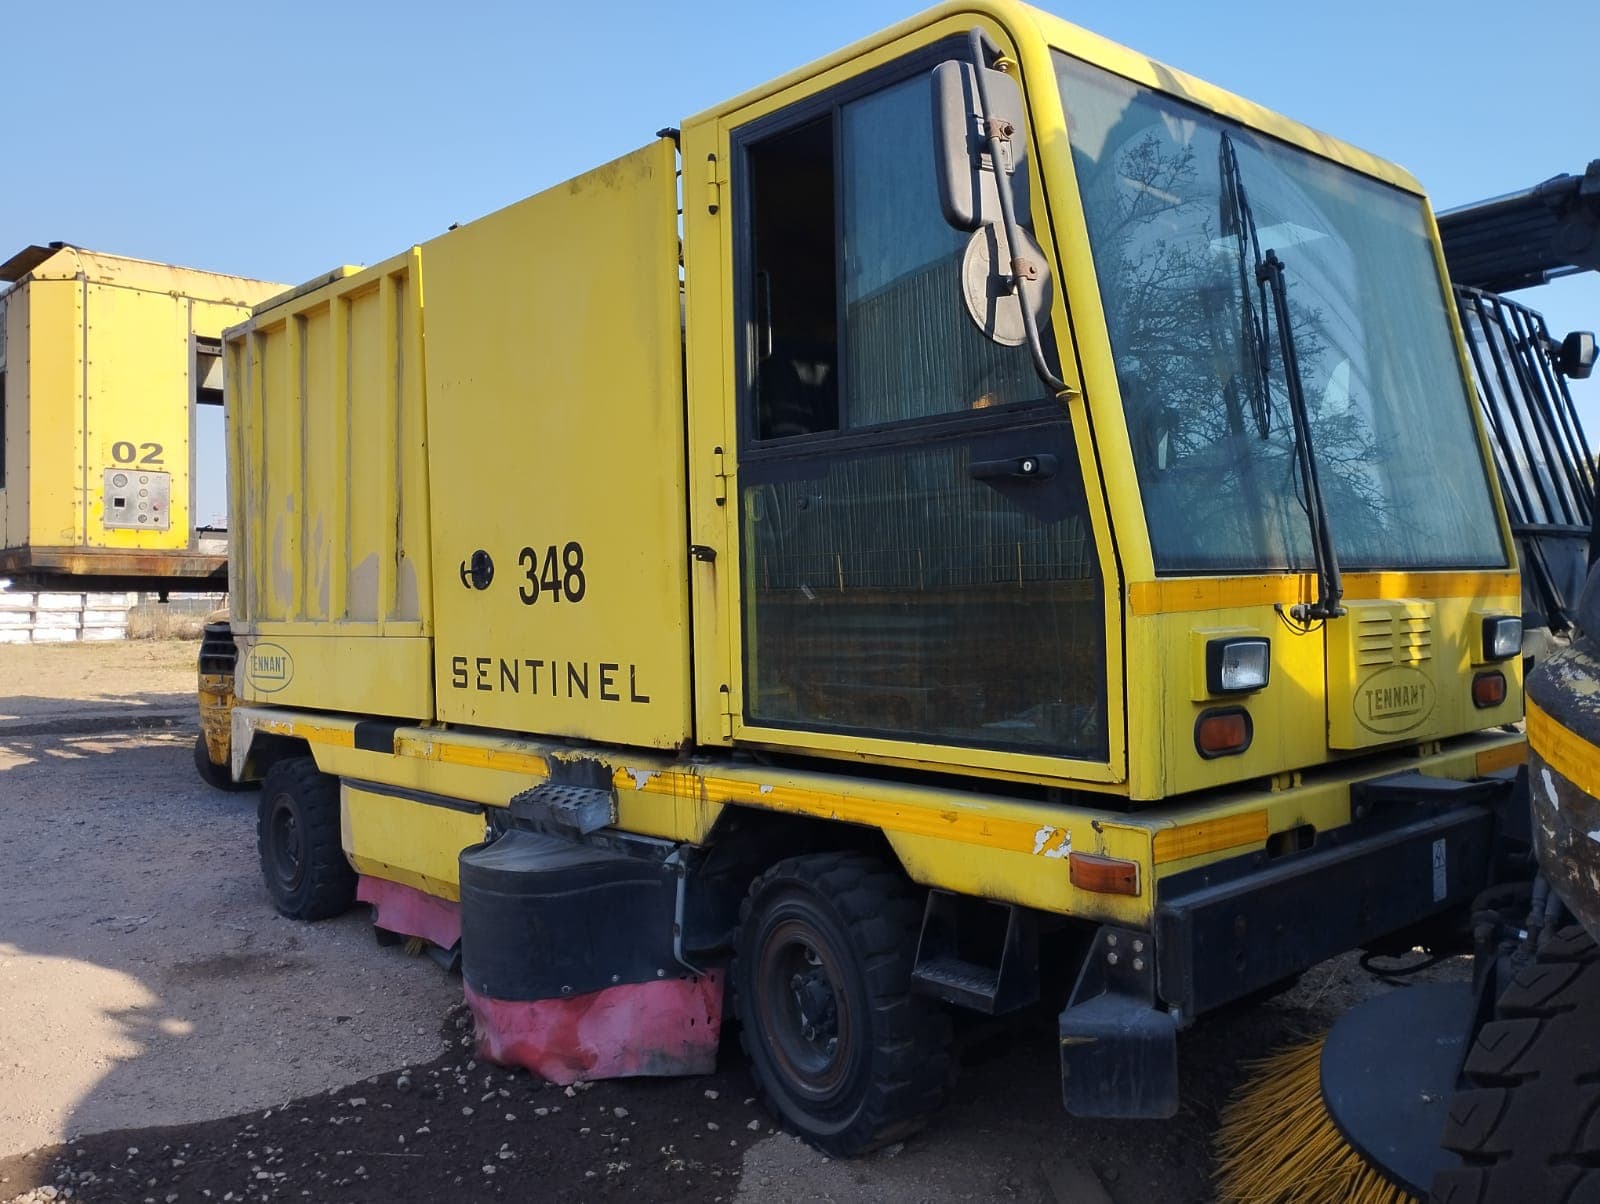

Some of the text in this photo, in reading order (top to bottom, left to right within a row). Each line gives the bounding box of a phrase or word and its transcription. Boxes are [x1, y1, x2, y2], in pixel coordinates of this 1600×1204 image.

[112, 441, 164, 464] 02
[518, 541, 586, 605] 348
[452, 656, 650, 704] SENTINEL
[1365, 684, 1426, 720] TENNANT
